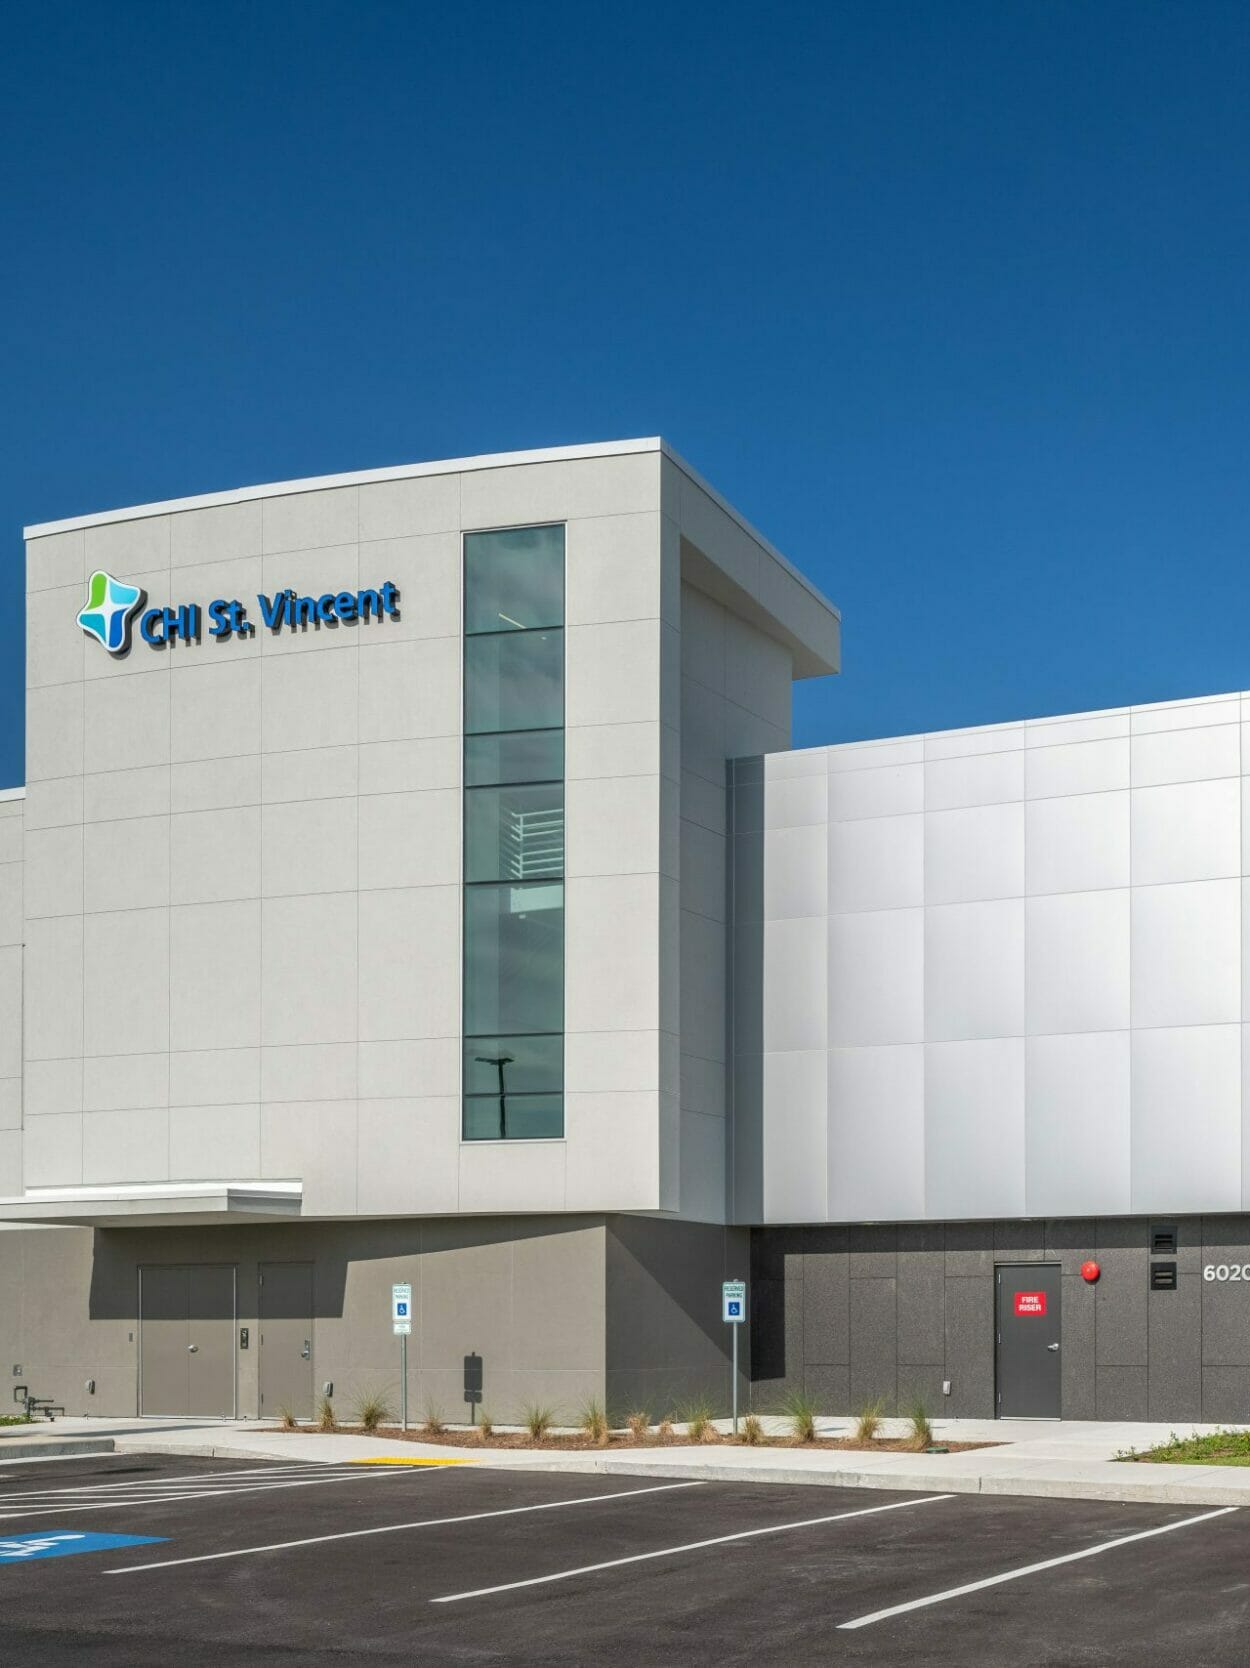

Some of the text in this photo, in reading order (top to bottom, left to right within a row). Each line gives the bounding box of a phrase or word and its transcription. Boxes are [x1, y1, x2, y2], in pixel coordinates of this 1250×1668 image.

[140, 581, 397, 646] CHI St. Vincent
[1021, 1296, 1039, 1304] FIRE
[1018, 1303, 1042, 1312] RISER
